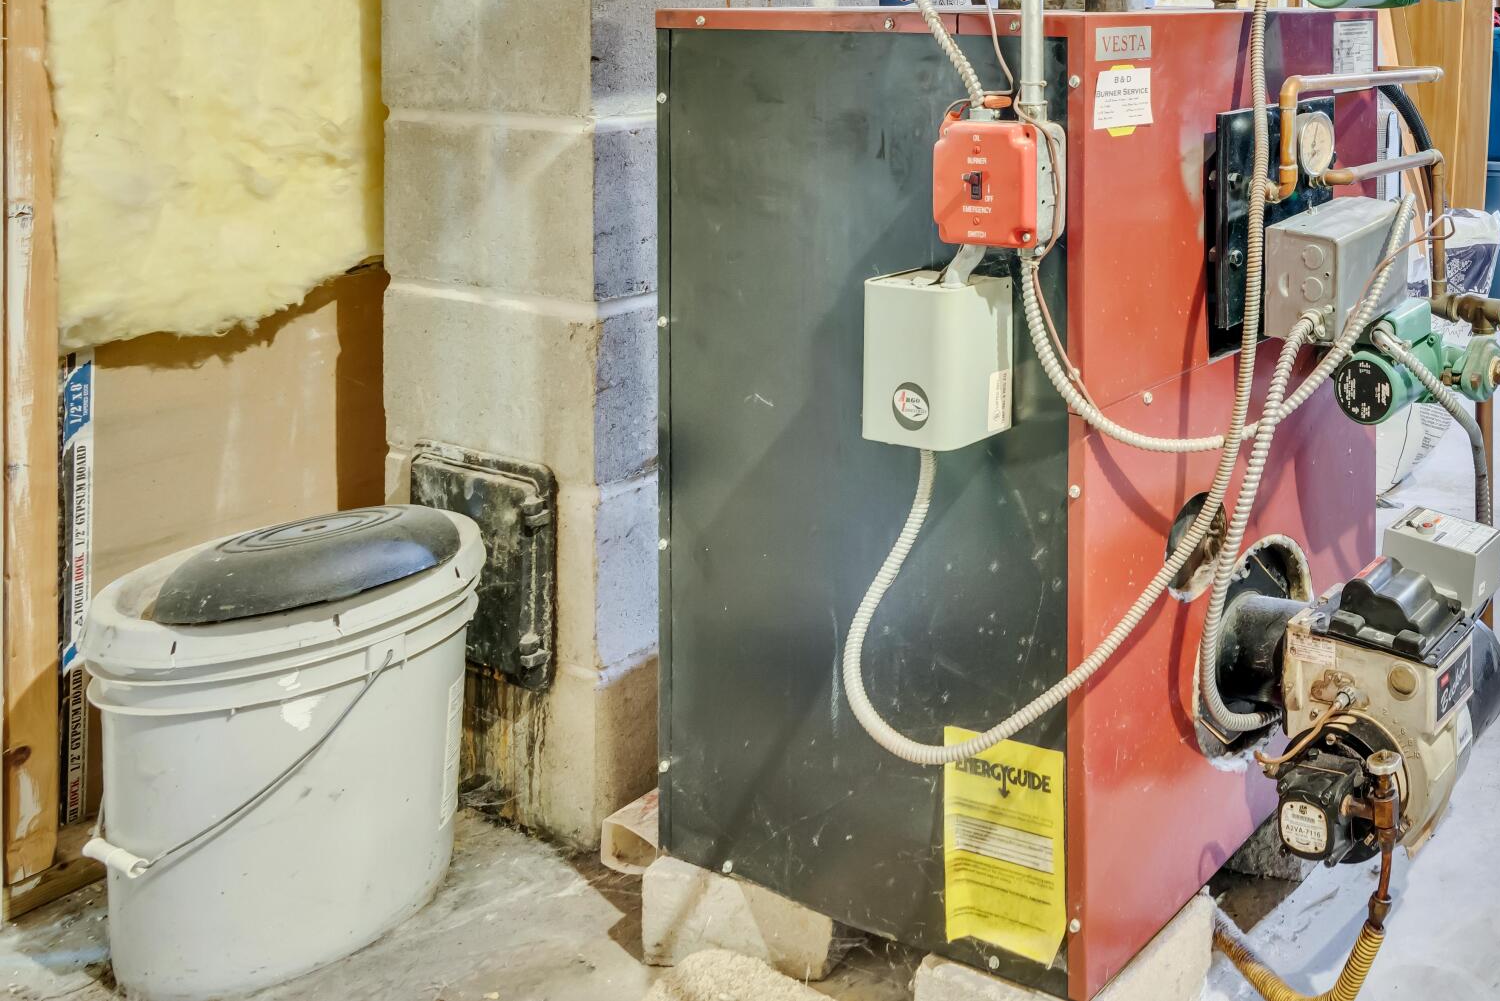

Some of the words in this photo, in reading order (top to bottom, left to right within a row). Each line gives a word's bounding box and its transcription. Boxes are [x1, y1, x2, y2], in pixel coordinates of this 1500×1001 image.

[1102, 34, 1146, 52] VESTA
[1126, 75, 1132, 83] D
[967, 157, 987, 165] BURNER
[962, 205, 992, 214] EMERGENCY
[968, 230, 986, 238] SWITCH
[76, 445, 86, 480] BOARD
[76, 483, 86, 526] GYPSUM
[70, 669, 83, 705] BOARD
[70, 707, 81, 750] GYPSUM
[955, 757, 1051, 794] ENERGYGUIDE
